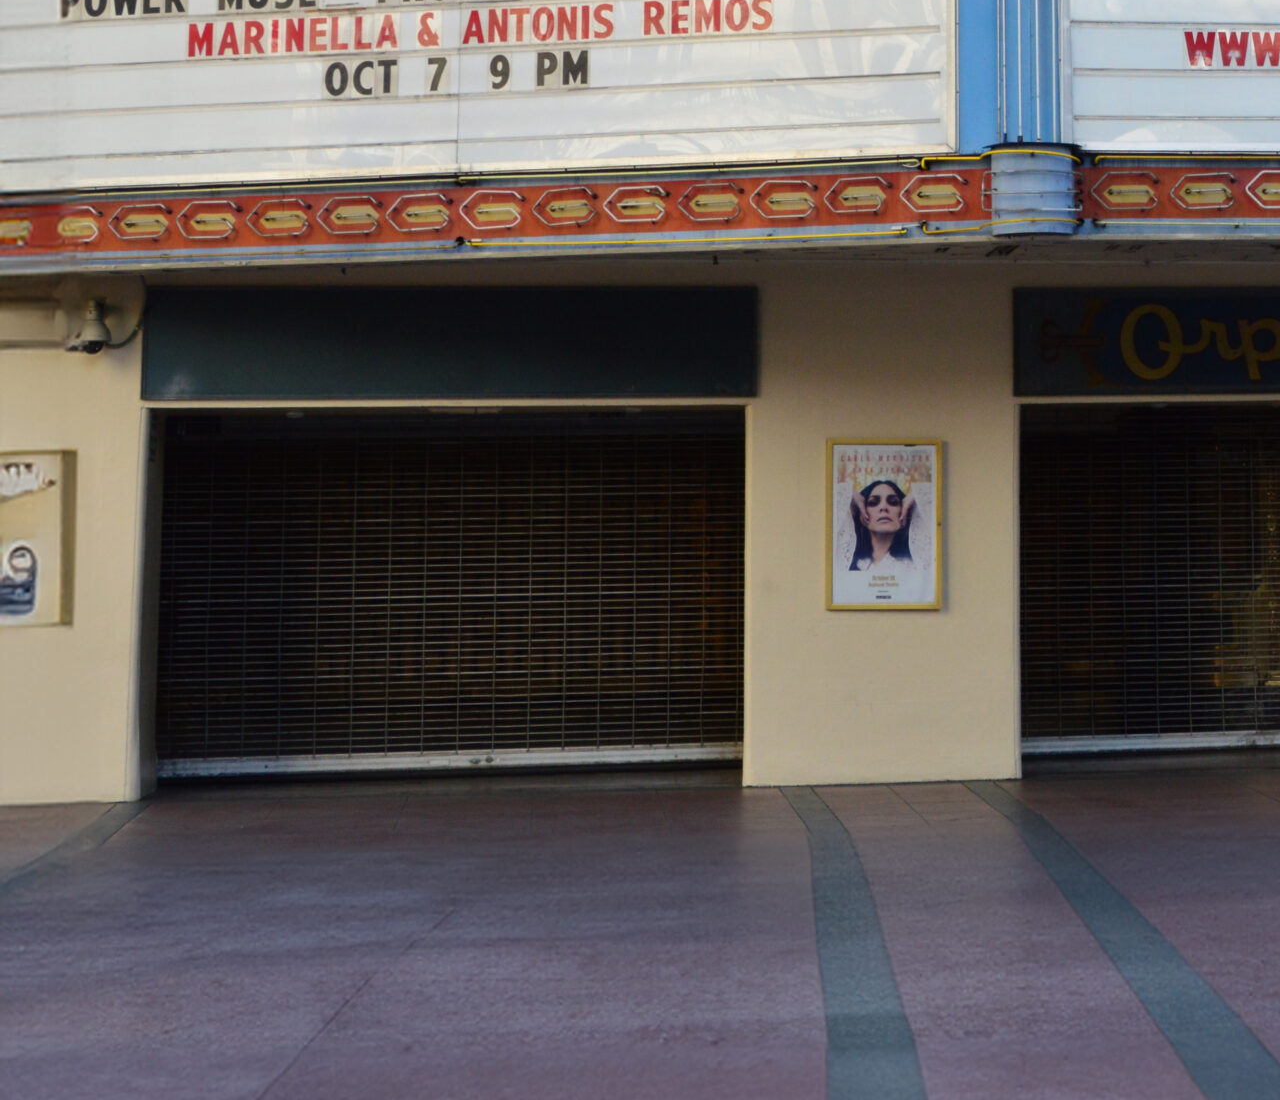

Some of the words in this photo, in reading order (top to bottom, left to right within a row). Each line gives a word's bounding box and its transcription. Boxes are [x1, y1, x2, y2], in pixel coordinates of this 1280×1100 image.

[188, 15, 398, 57] MARINELLA
[418, 12, 439, 46] &
[462, 4, 614, 45] ANTONIS
[325, 59, 397, 96] OCT
[429, 57, 449, 91] 7
[490, 54, 511, 88] 9
[536, 50, 589, 86] PM
